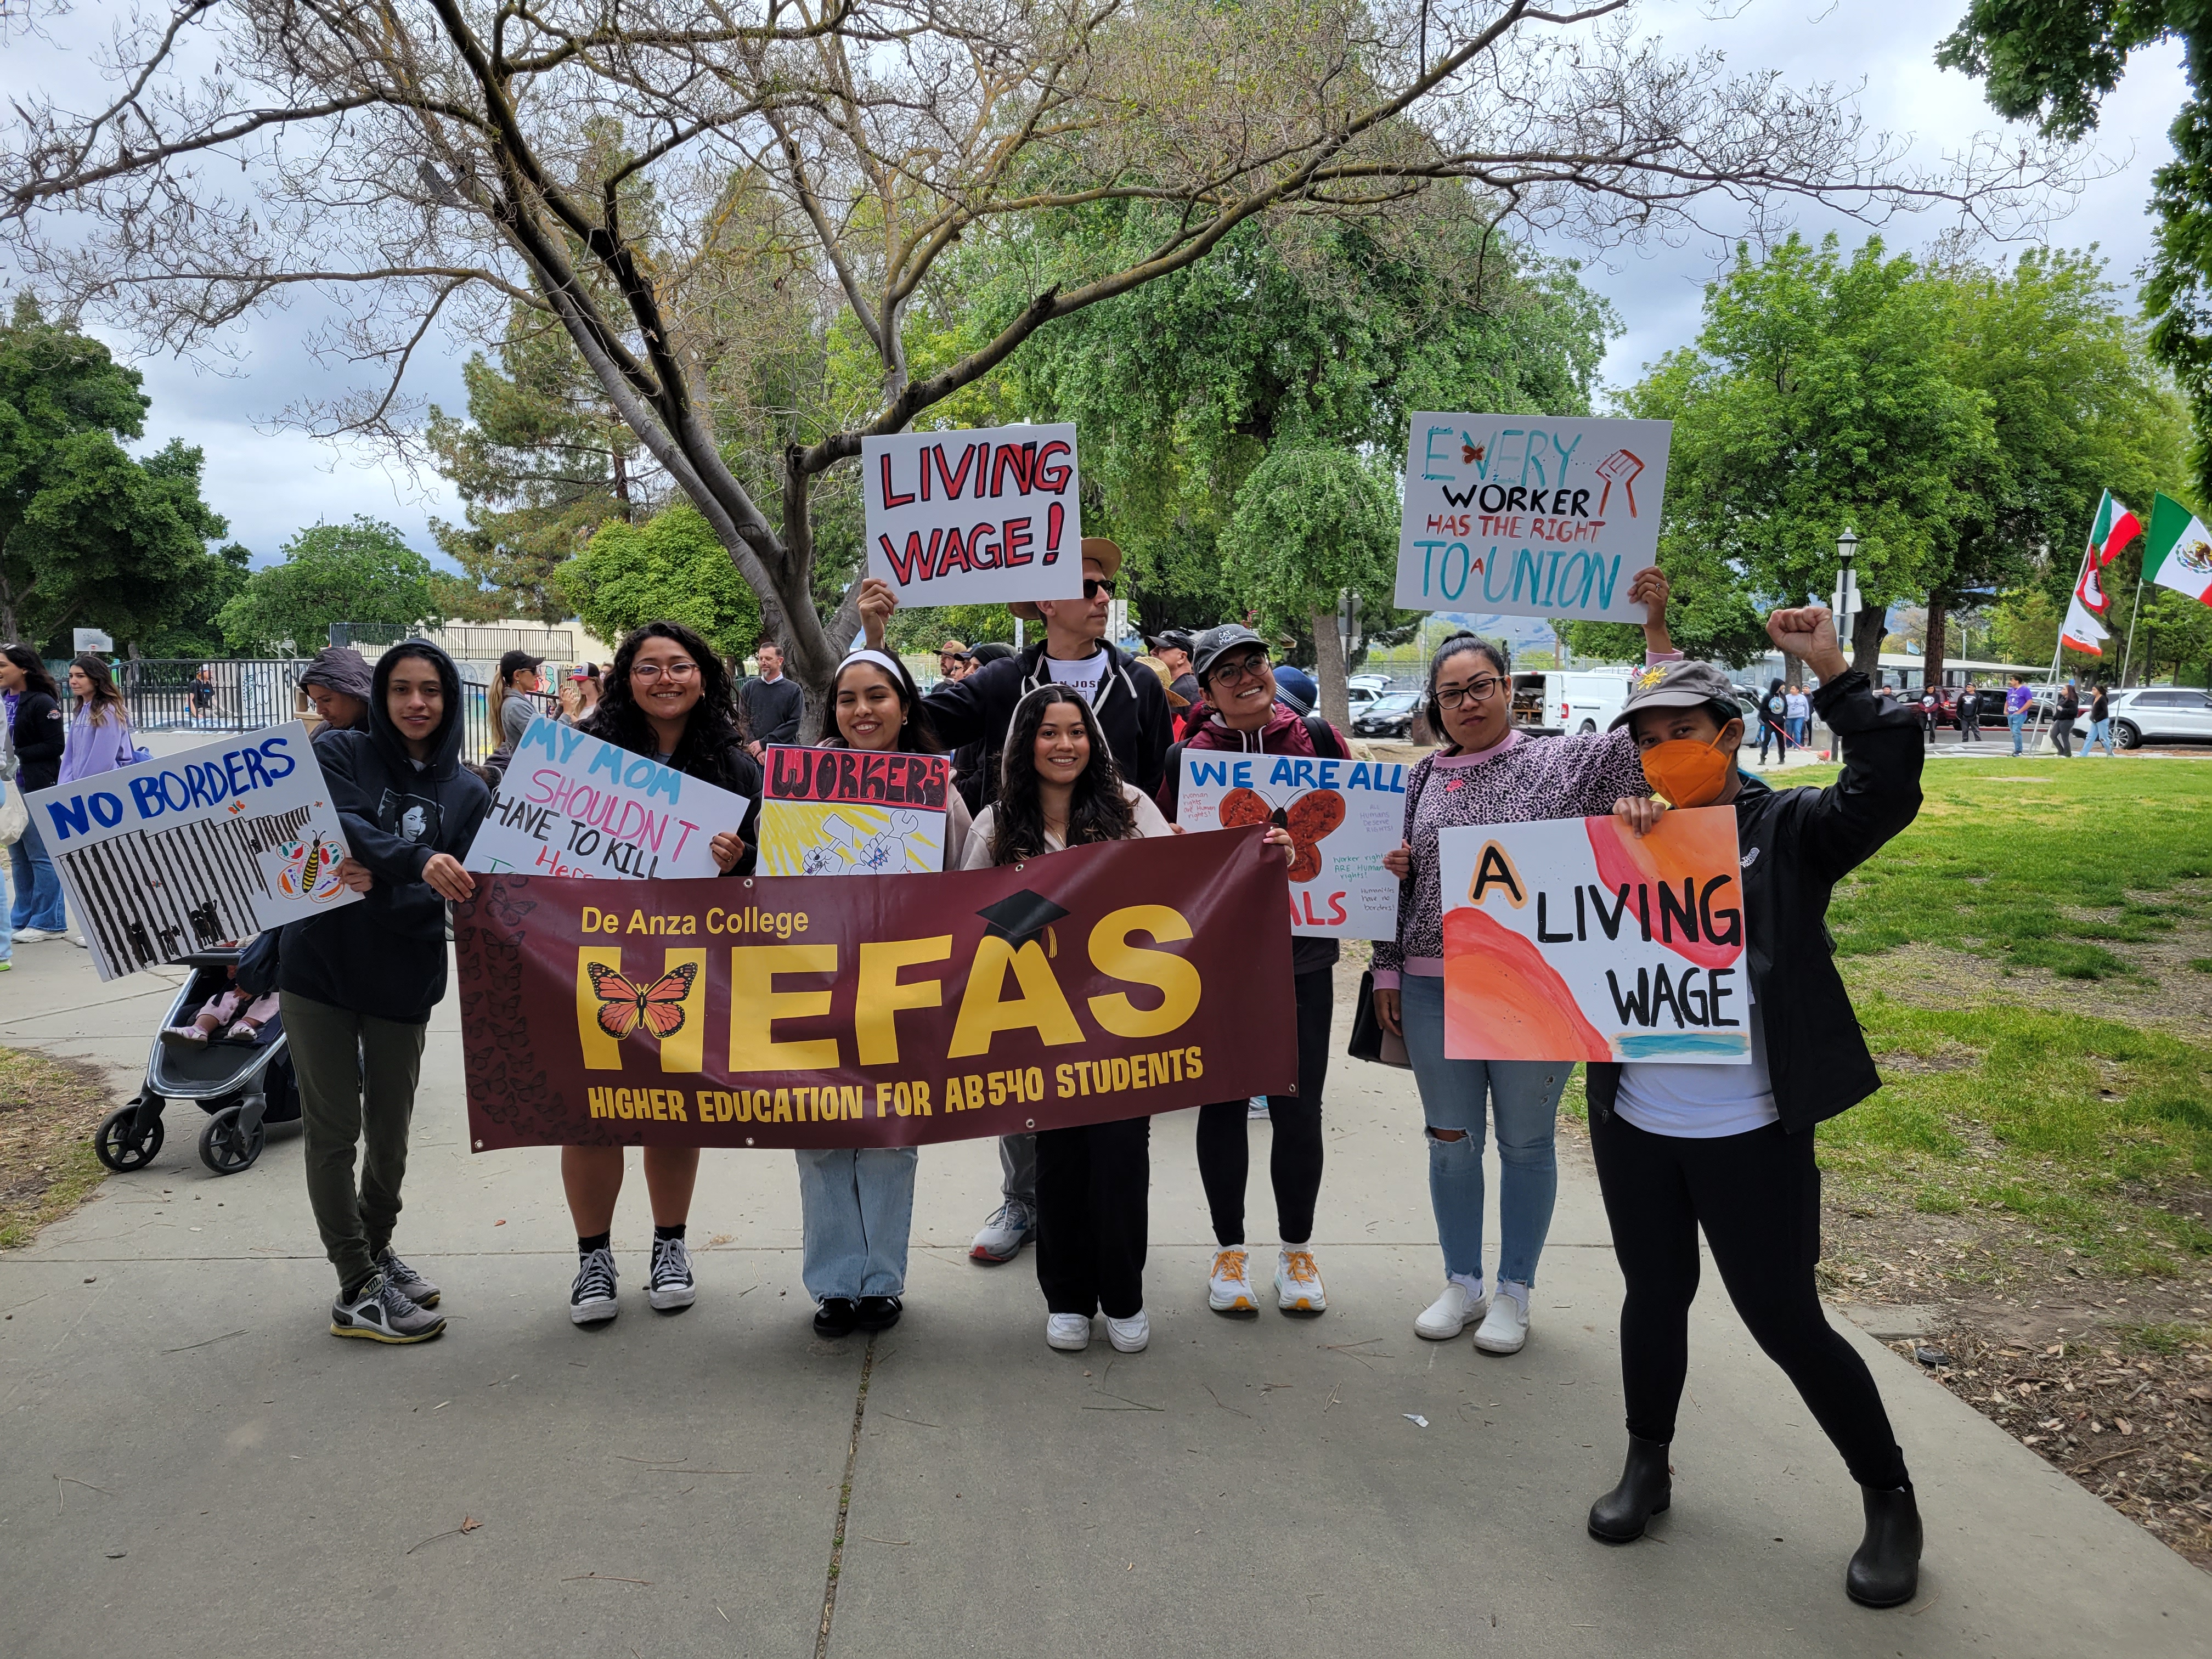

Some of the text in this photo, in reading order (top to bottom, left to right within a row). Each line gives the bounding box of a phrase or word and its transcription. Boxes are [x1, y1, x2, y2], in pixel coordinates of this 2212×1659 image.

[881, 440, 1073, 510] LIVING
[1424, 426, 1583, 488] EVERY
[1426, 514, 1606, 543] HAS THE RIGHT
[1442, 484, 1591, 518] WORKER
[878, 501, 1065, 587] WAGE!
[1413, 540, 1470, 601] TO
[1483, 546, 1621, 611] UNION
[1218, 630, 1231, 639] CAT
[1218, 634, 1238, 645] MOM
[46, 738, 296, 840] NO BORDERS
[521, 716, 681, 805] MY MOM
[771, 749, 945, 808] WORKERS
[1190, 757, 1406, 793] WE ARE ALL
[486, 791, 662, 880] HAVE TO KILL
[526, 769, 700, 862] SHOULDN'T
[1334, 865, 1351, 873] ARE
[1340, 872, 1367, 883] rights!
[1472, 845, 1522, 902] A
[582, 906, 809, 938] De Anza College
[1537, 874, 1741, 946] LIVING
[576, 904, 1201, 1073] HEFAS
[1606, 963, 1740, 1029] WAGE
[587, 1046, 1204, 1123] HIGHER EDUCATION FOR AB540 STUDENTS
